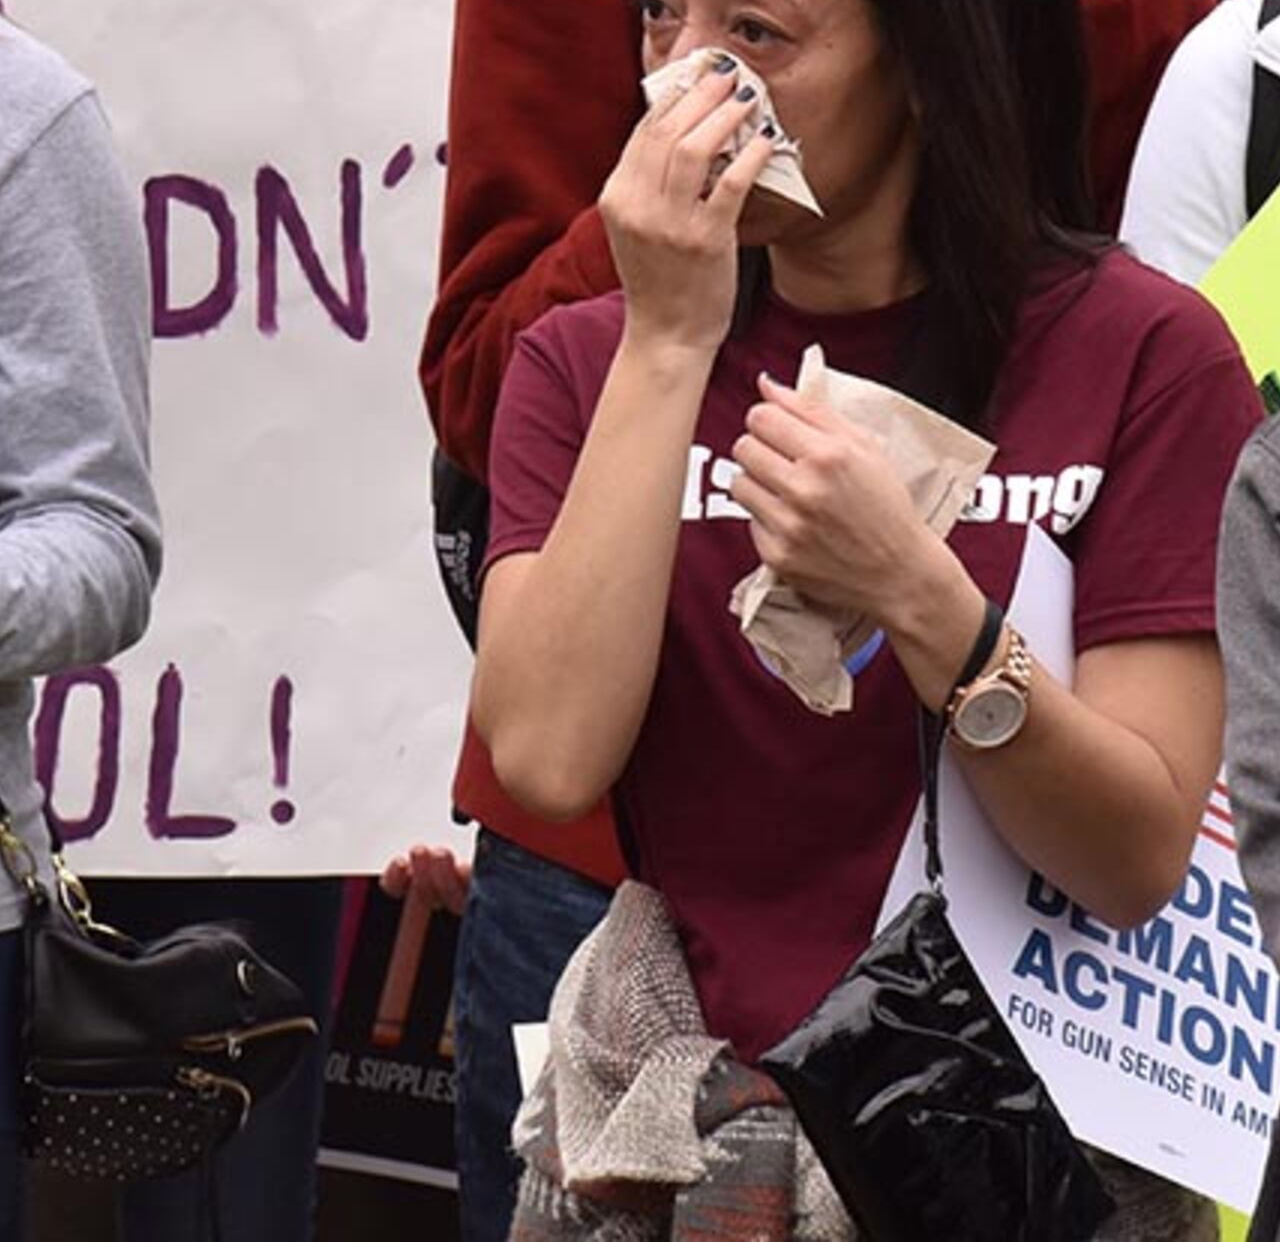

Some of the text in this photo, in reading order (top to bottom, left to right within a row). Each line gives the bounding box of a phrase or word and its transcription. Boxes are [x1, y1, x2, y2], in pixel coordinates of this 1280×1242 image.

[354, 1060, 460, 1104] SUPPLIES
[1007, 994, 1276, 1139] FOR GUN SENSE IN AM
[1012, 928, 1277, 1096] ACTION
